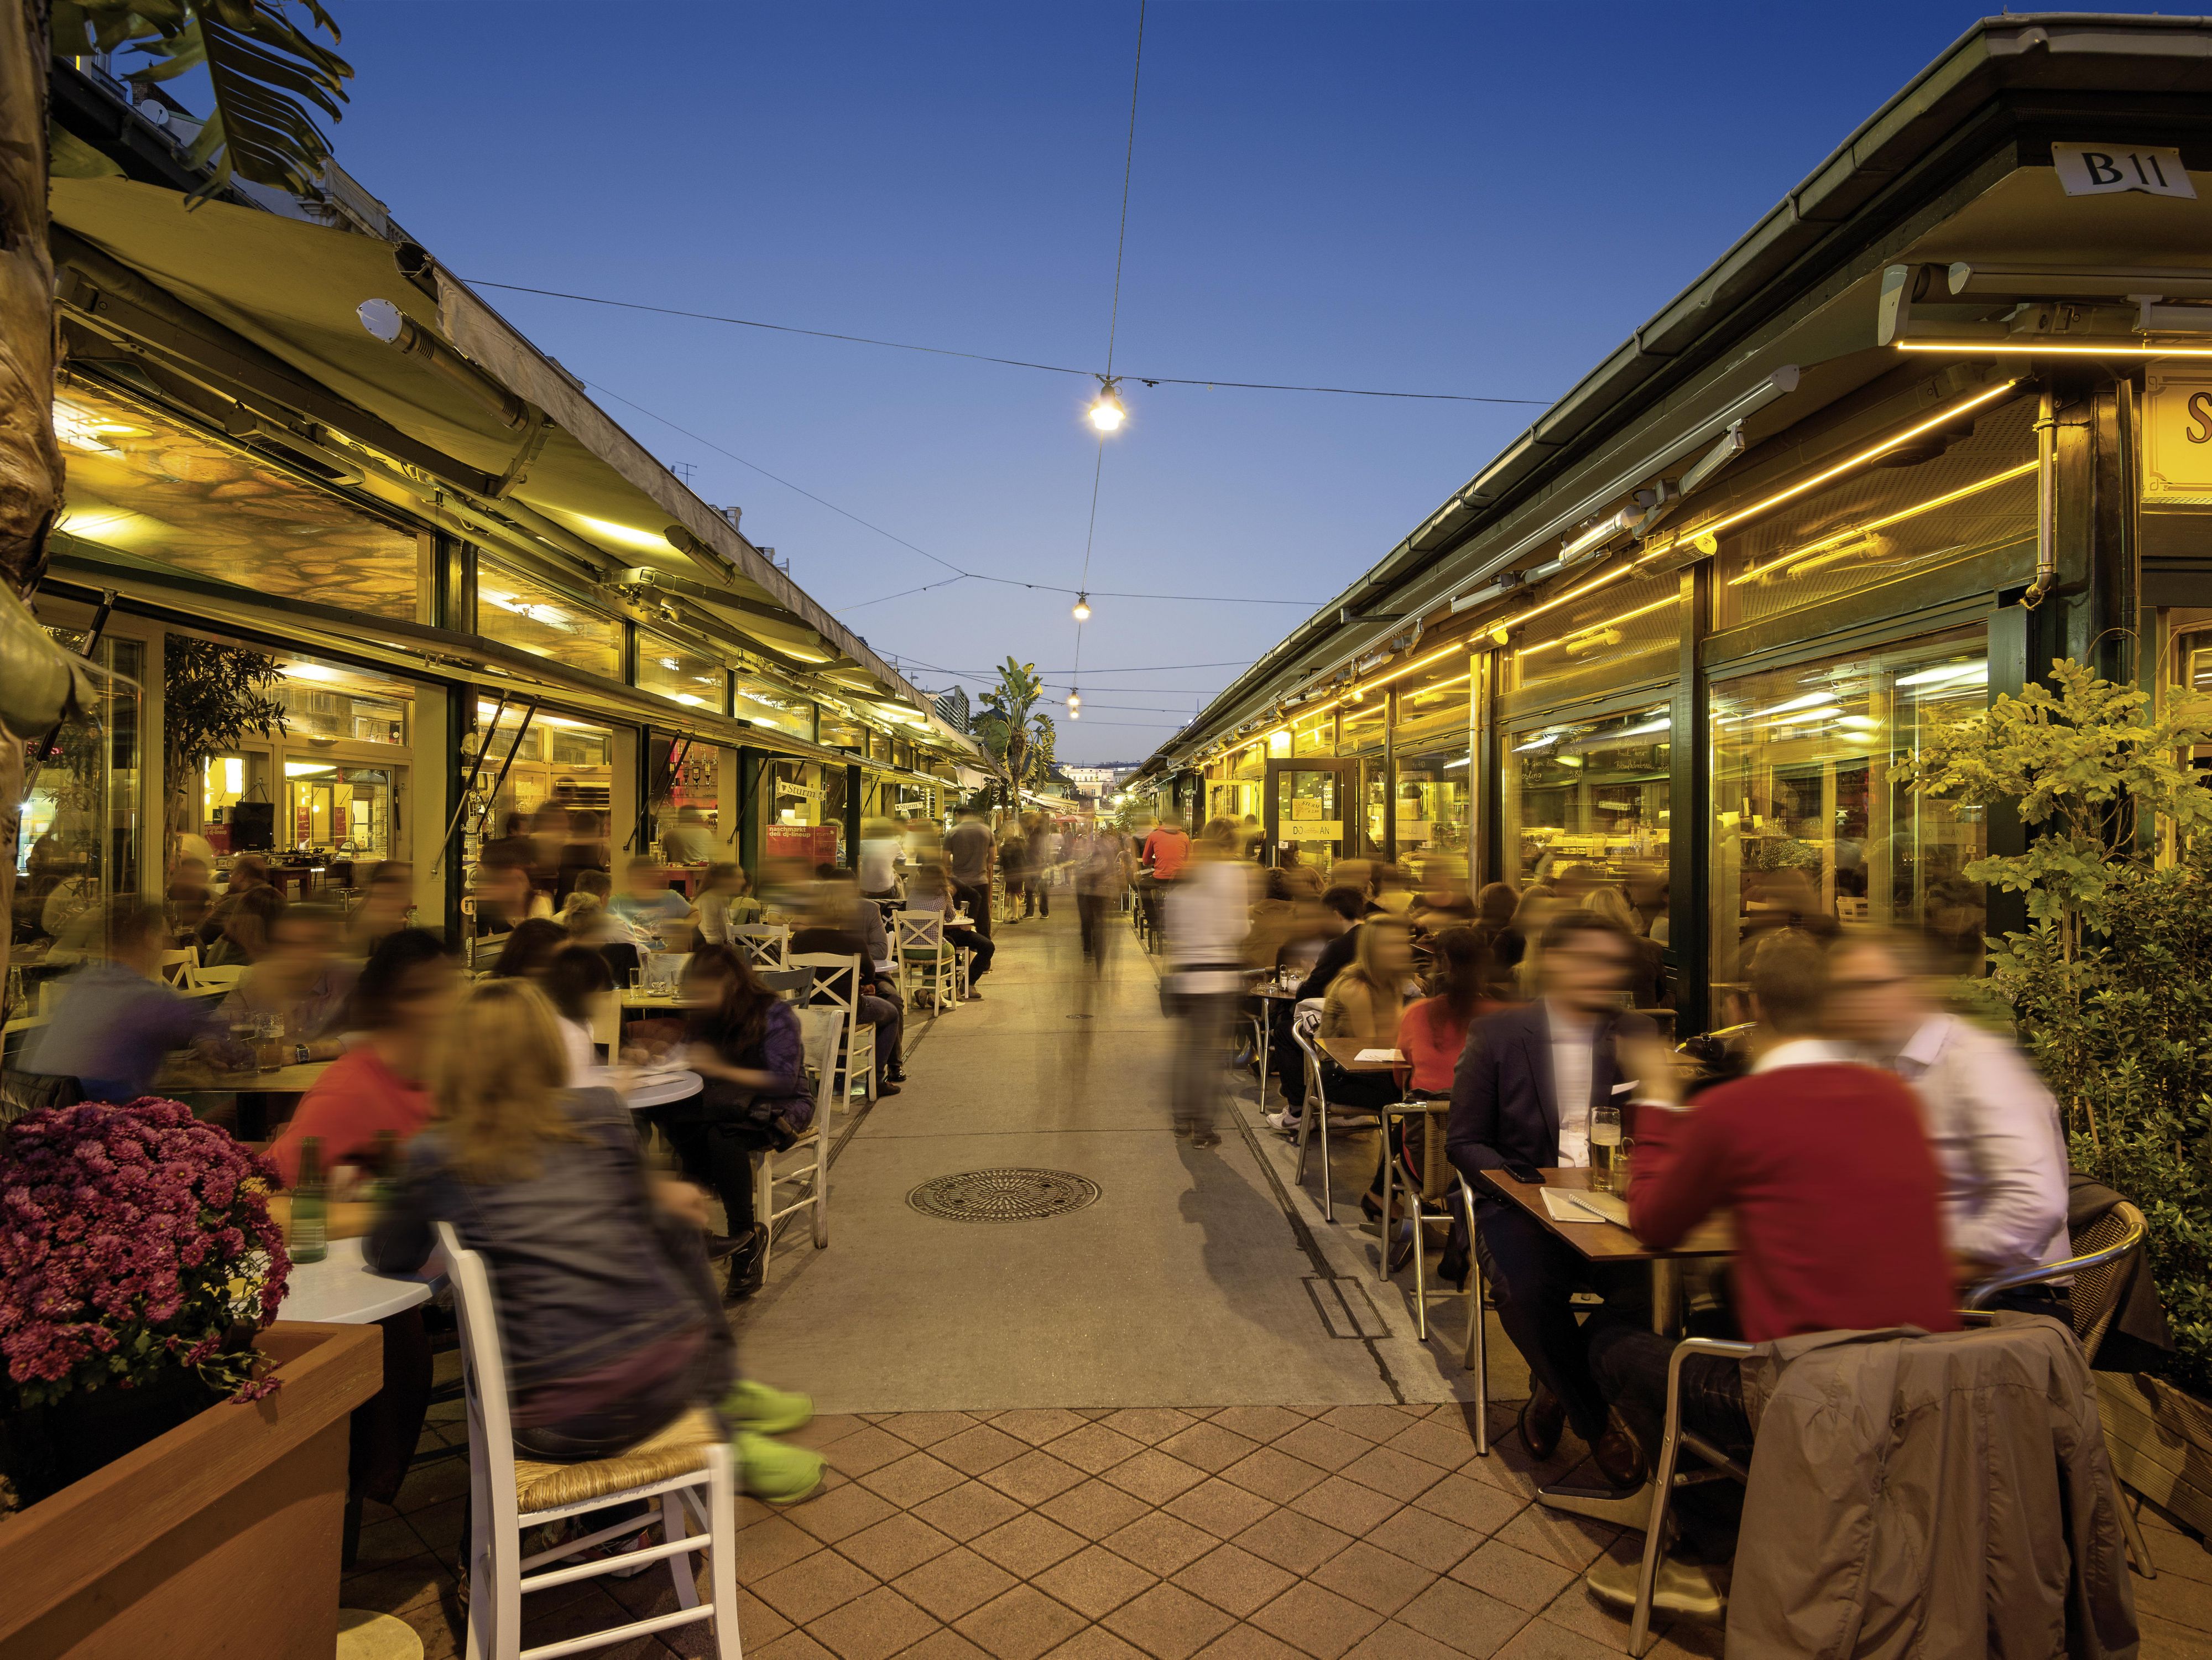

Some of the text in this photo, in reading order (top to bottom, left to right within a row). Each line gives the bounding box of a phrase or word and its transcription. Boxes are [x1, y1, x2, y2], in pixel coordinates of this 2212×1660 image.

[2186, 392, 2212, 444] S
[1567, 770, 1583, 779] 3,80
[787, 784, 816, 798] Sturm
